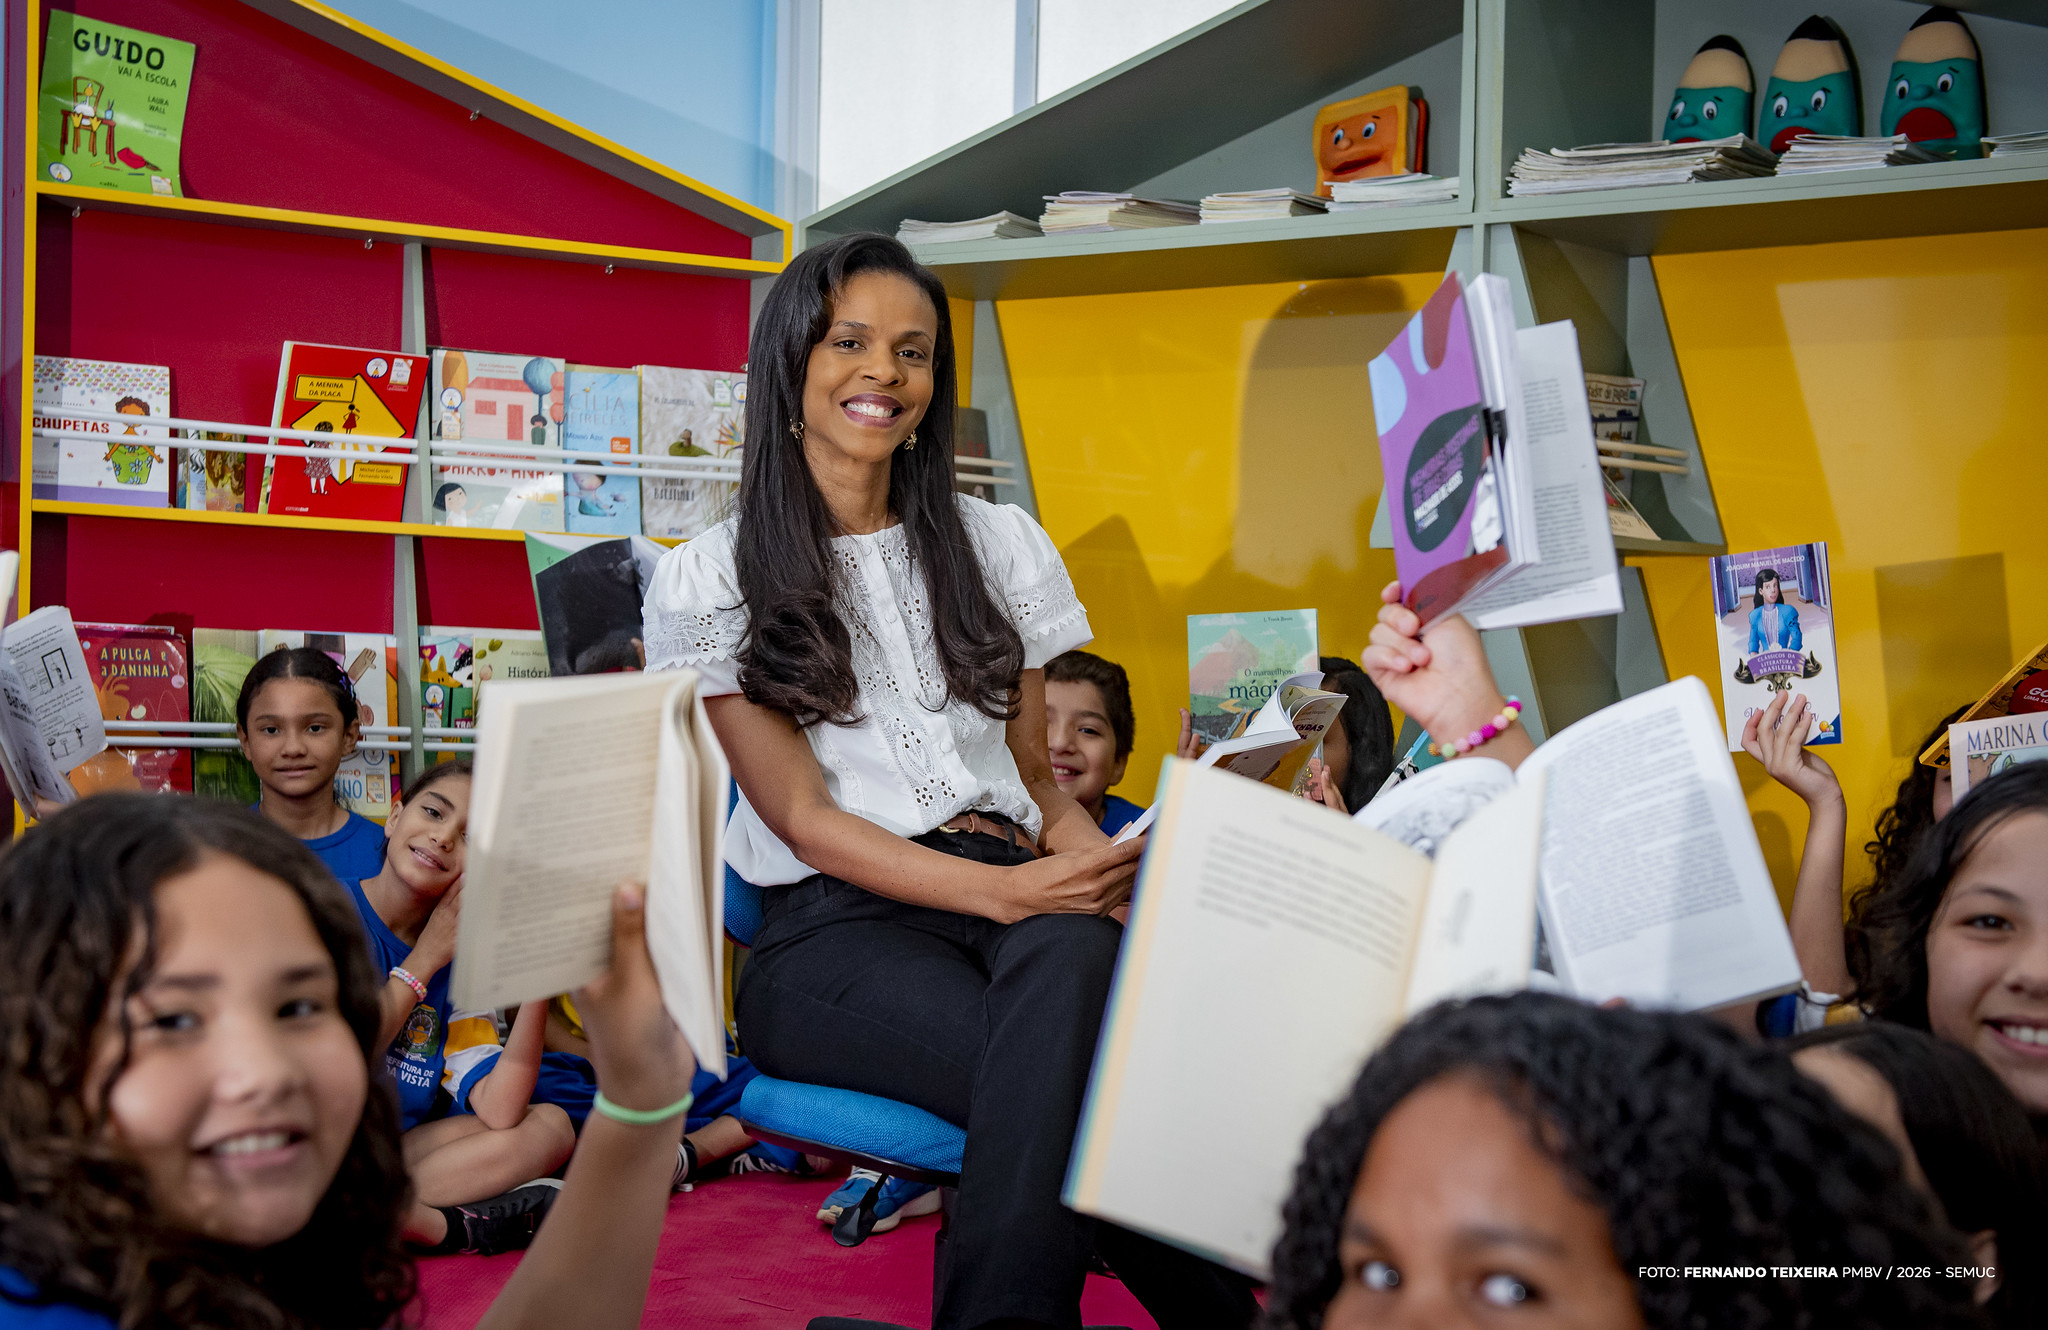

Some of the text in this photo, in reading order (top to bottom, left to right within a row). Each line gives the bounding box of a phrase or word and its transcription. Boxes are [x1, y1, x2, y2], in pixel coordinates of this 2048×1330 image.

[73, 28, 165, 71] GUIDO
[118, 66, 133, 77] VAI
[145, 72, 177, 88] ESCOLA
[147, 96, 169, 106] LAURA
[148, 104, 166, 114] WALL
[32, 417, 110, 434] CHUPETAS
[101, 647, 167, 662] A PULGA e
[101, 663, 170, 678] a DANINHA
[1759, 664, 1796, 675] BRASILEIRA
[1760, 659, 1793, 667] LITERATURA
[1244, 668, 1252, 677] O
[1967, 723, 2036, 752] MARINA
[400, 1070, 430, 1087] VISTA
